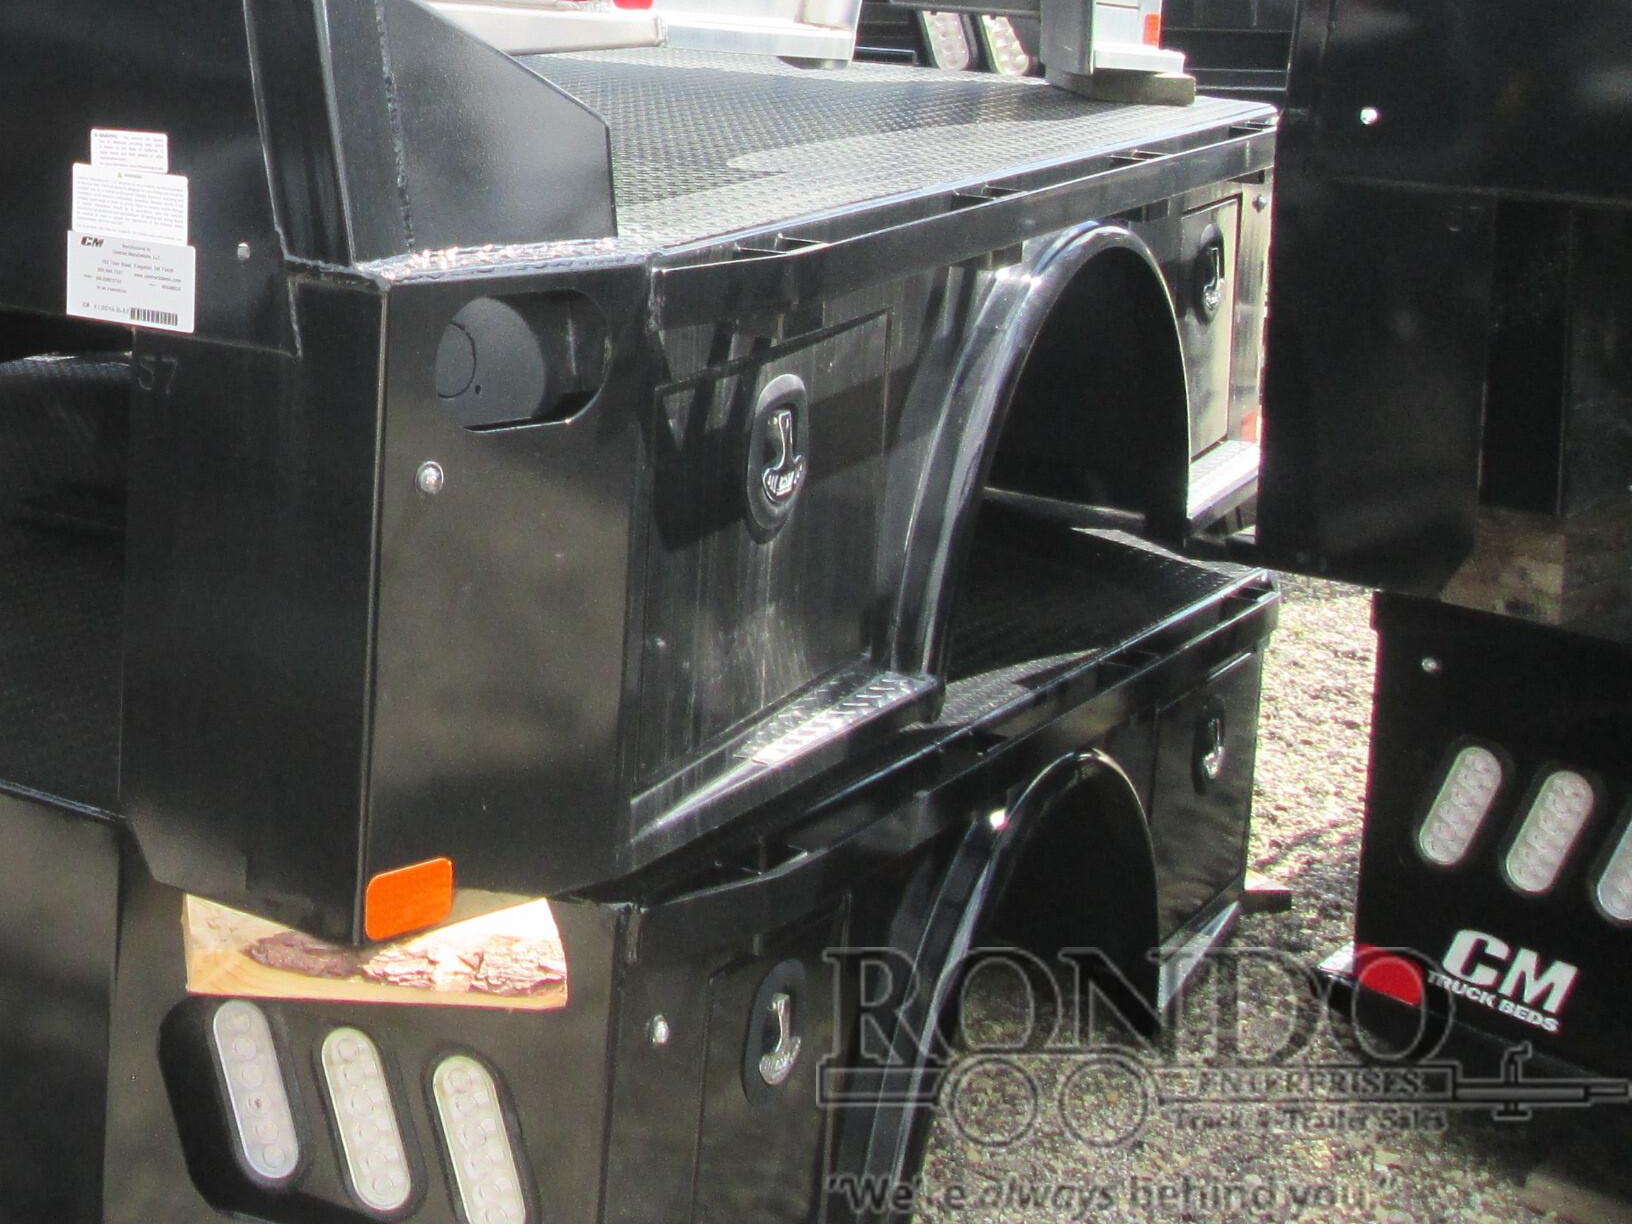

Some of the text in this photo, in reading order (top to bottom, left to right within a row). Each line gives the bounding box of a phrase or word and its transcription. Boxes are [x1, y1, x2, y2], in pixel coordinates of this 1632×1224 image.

[80, 236, 104, 248] CM
[1427, 969, 1561, 1033] TRUCK BEDS
[1442, 929, 1579, 1014] CM
